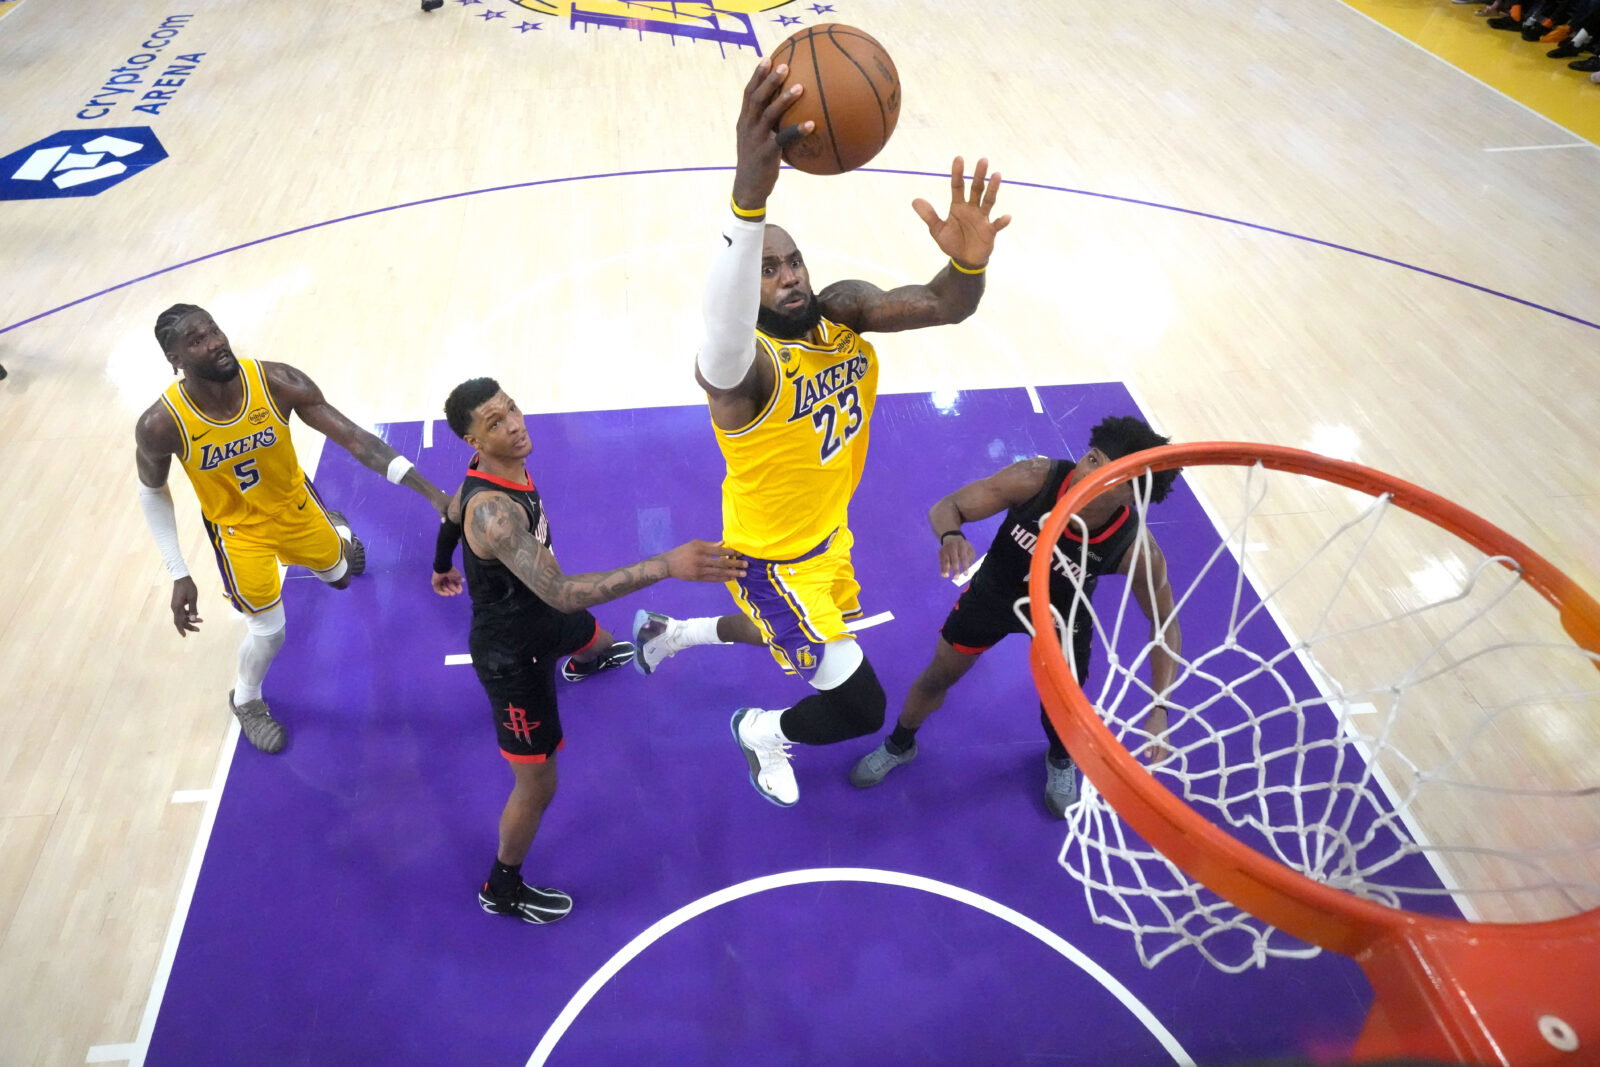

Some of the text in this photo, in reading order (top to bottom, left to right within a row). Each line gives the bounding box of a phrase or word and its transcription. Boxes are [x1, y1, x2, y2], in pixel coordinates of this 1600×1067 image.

[76, 14, 194, 120] crypto.com
[131, 52, 207, 116] ARENA
[786, 349, 869, 423] LAKERS
[199, 426, 277, 471] LAKERS
[812, 384, 863, 466] 23
[233, 458, 261, 494] 5
